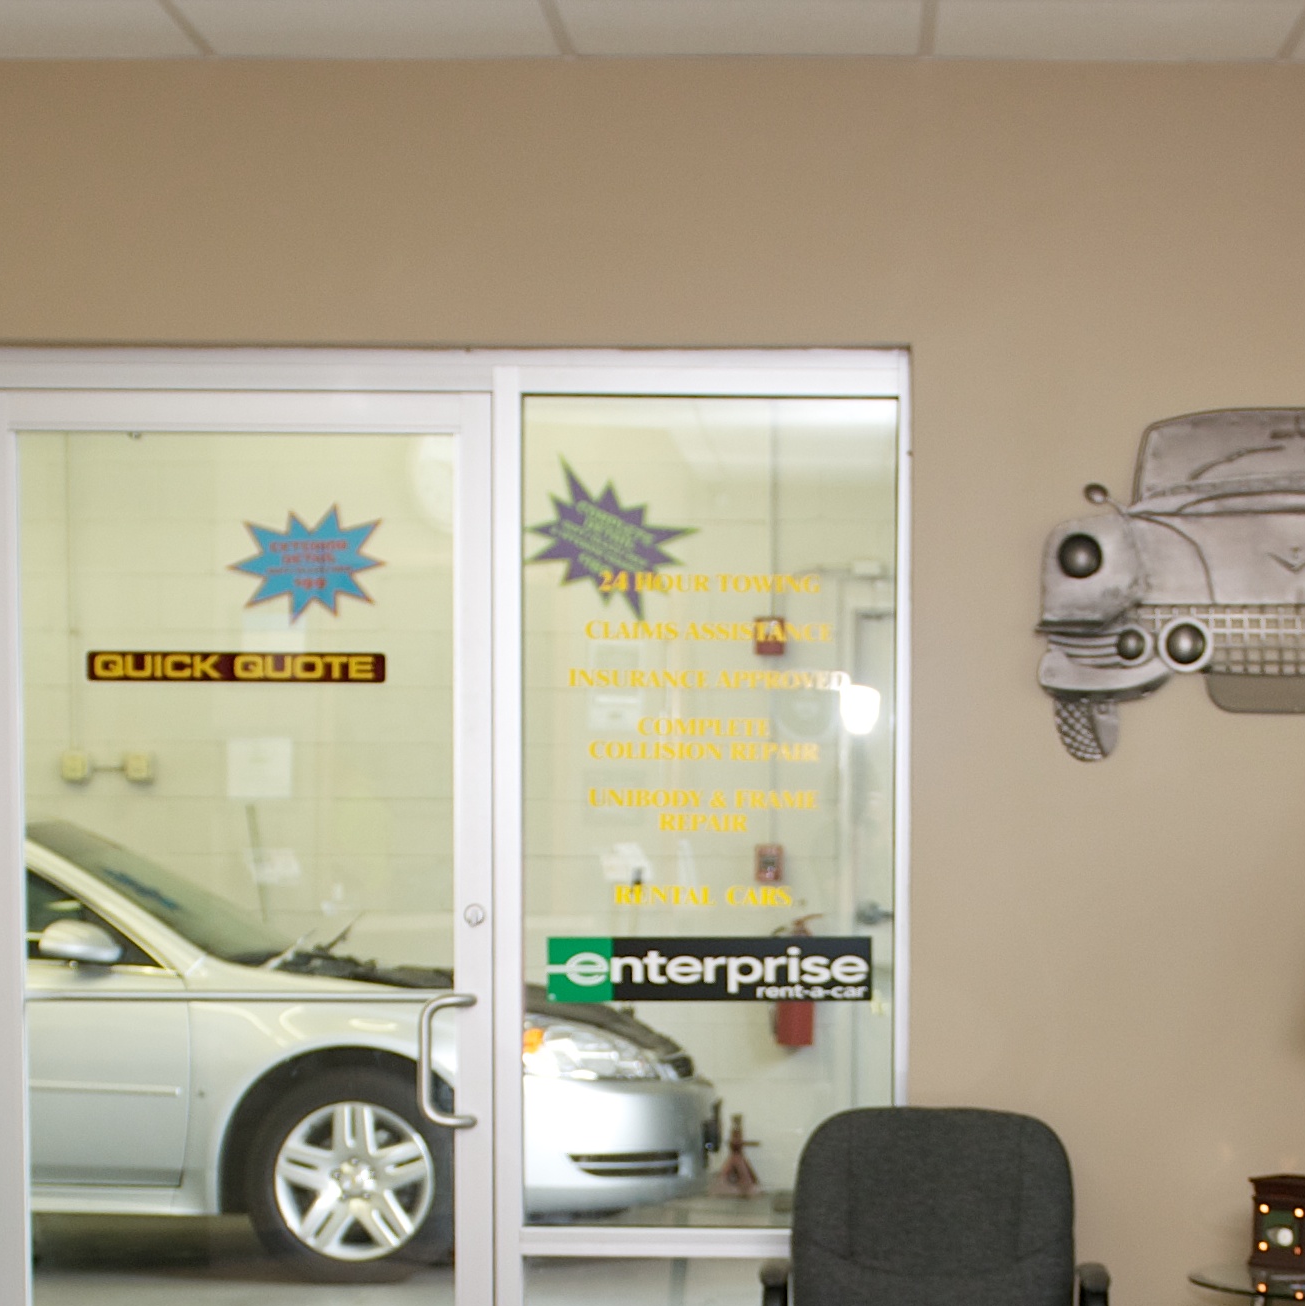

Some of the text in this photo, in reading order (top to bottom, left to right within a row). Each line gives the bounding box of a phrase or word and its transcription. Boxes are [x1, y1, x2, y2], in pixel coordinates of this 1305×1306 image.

[599, 570, 821, 594] 24 HOUR TOWING
[585, 620, 834, 642] CLAIMS ASSISTANCE
[95, 654, 375, 680] QUICK QUOTE
[568, 668, 851, 690] INSURANCE APPROVED
[638, 717, 770, 738] COMPLETE
[588, 740, 820, 763] COLLISION REPAIR
[588, 788, 820, 810] UNIBODY & FRAME
[659, 812, 748, 833] REPAIR
[614, 885, 792, 907] RENTAL CARS
[561, 945, 870, 994] enterprise
[756, 985, 868, 999] rent-a-car
